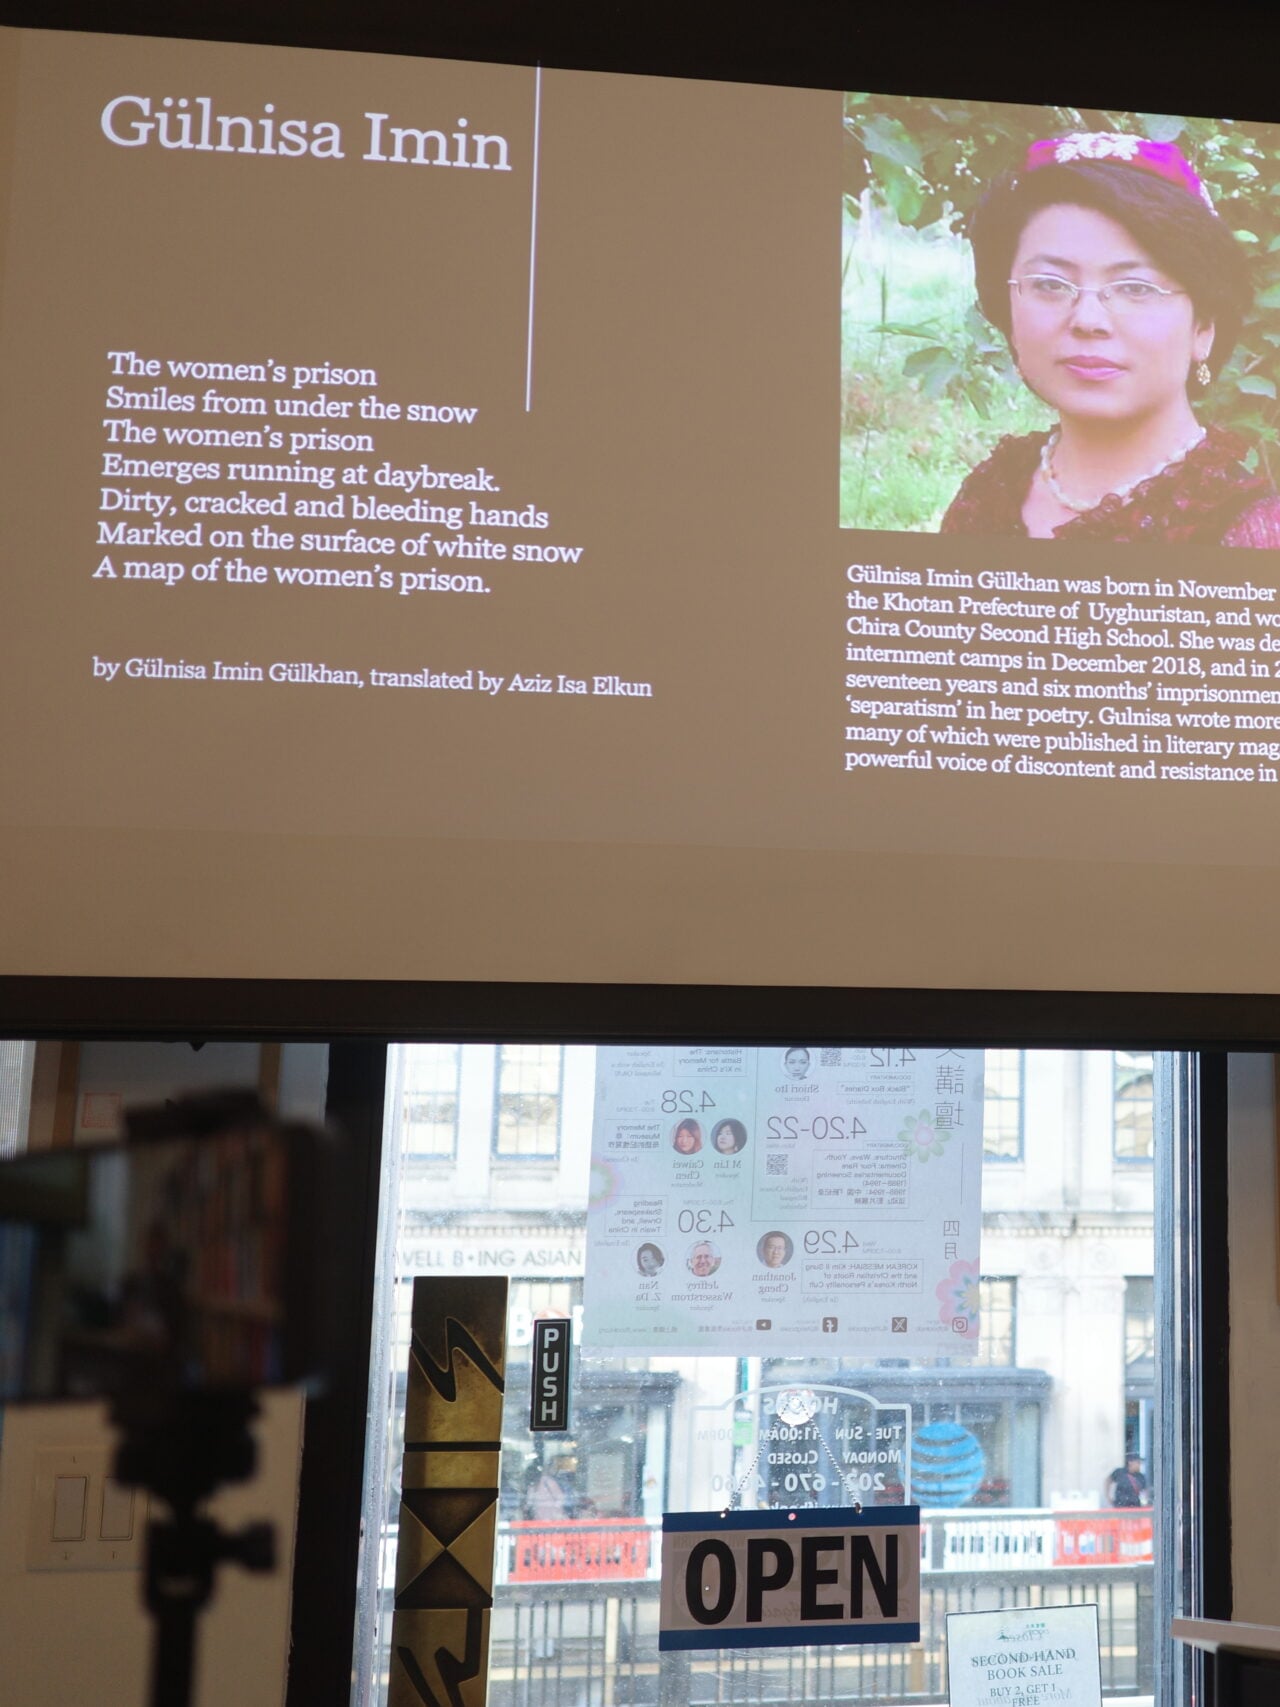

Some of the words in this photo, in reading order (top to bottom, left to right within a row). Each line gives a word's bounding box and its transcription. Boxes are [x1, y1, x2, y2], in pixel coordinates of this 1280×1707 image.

[100, 95, 345, 159] Gülnisa
[362, 112, 513, 171] Imin
[107, 350, 162, 377] The
[291, 361, 378, 390] prison
[105, 385, 196, 412] Smiles
[201, 388, 268, 416] from
[273, 393, 354, 419] under
[358, 394, 402, 421] the
[406, 404, 479, 424] snow
[102, 418, 157, 444] The
[288, 427, 375, 456] prison
[100, 452, 221, 485] Emerges
[226, 459, 336, 490] running
[341, 464, 369, 485] at
[373, 461, 501, 493] daybreak.
[99, 487, 178, 518] Dirty,
[184, 490, 288, 516] cracked
[293, 494, 346, 519] and
[350, 494, 464, 530] bleeding
[468, 500, 549, 529] hands
[95, 520, 204, 547] Marked
[209, 530, 245, 548] on
[250, 524, 295, 551] the
[300, 528, 396, 555] surface
[400, 532, 432, 557] of
[432, 533, 507, 561] white
[511, 544, 584, 564] snow
[91, 555, 118, 579] A
[122, 561, 185, 586] map
[191, 556, 223, 582] of
[223, 557, 268, 584] the
[398, 567, 491, 596] prison.
[846, 564, 923, 586] Gülnisa
[925, 567, 975, 589] Imin
[977, 570, 1061, 593] Gülkhan
[1062, 579, 1102, 595] was
[1104, 575, 1152, 597] born
[1154, 578, 1175, 597] in
[1177, 579, 1277, 602] November
[845, 589, 879, 610] the
[882, 591, 955, 614] Khotan
[958, 595, 1056, 619] Prefecture
[1059, 600, 1081, 620] of
[1087, 601, 1211, 628] Uyghuristan,
[1215, 607, 1252, 626] and
[846, 615, 901, 637] Chira
[904, 619, 977, 645] County
[979, 622, 1050, 644] Second
[1053, 626, 1103, 650] High
[1106, 627, 1175, 649] School.
[1179, 629, 1215, 650] She
[1217, 636, 1256, 652] was
[92, 655, 122, 682] by
[124, 657, 207, 680] Gülnisa
[212, 660, 264, 682] Imin
[268, 662, 365, 689] Gülkhan,
[369, 667, 474, 690] translated
[477, 670, 505, 696] by
[506, 673, 553, 693] Aziz
[556, 674, 588, 695] Isa
[591, 675, 653, 697] Elkun
[845, 642, 957, 666] internment
[959, 652, 1023, 673] camps
[1026, 650, 1047, 671] in
[1051, 652, 1148, 674] December
[1151, 655, 1206, 679] 2018,
[1210, 657, 1248, 677] and
[1249, 658, 1271, 678] in
[965, 700, 987, 720] in
[989, 700, 1024, 722] her
[1026, 706, 1094, 729] poetry.
[1098, 706, 1173, 727] Gulnisa
[1175, 711, 1231, 729] wrote
[522, 1249, 582, 1267] ASIAN
[541, 1328, 560, 1422] PUSH
[684, 1533, 899, 1628] OPEN
[971, 1647, 1077, 1668] SECOND-HAND
[987, 1666, 1026, 1681] BOOK
[1030, 1663, 1063, 1677] SALE
[990, 1685, 1012, 1698] BUY
[1026, 1683, 1049, 1694] GET
